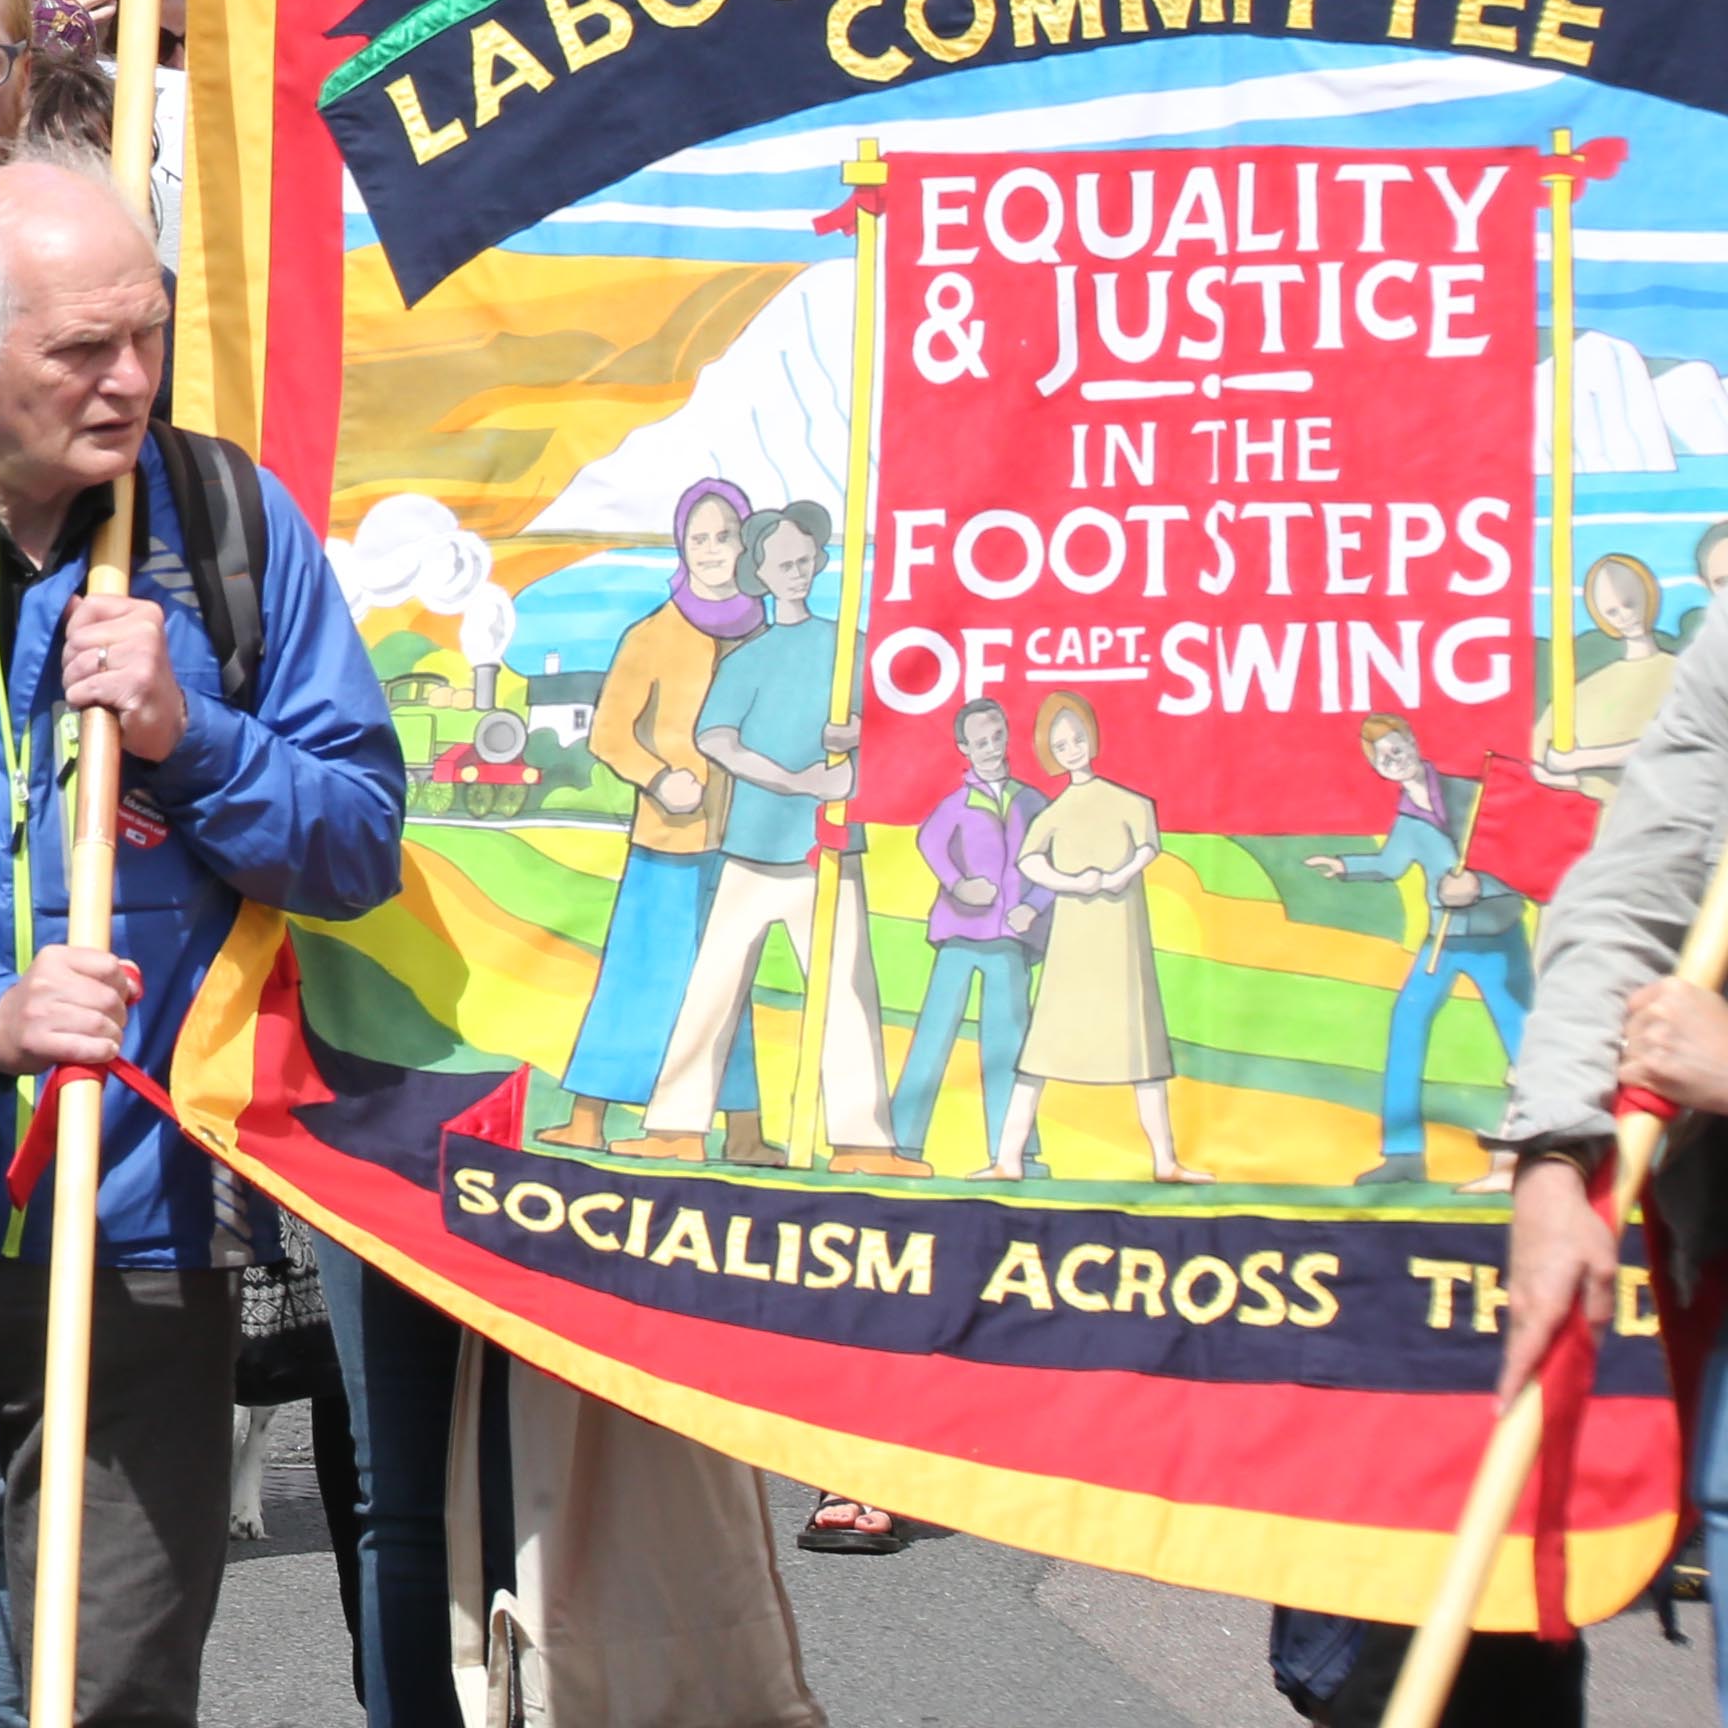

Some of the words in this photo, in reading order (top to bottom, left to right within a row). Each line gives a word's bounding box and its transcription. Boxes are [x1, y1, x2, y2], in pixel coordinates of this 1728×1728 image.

[917, 162, 1510, 266] EQUALITY
[912, 272, 990, 384] &
[1036, 260, 1492, 398] JUSTICE
[1070, 421, 1157, 489] IN
[1192, 417, 1340, 485] THE
[884, 497, 1512, 602] FOOTSTEPS
[871, 626, 1013, 715] OF
[1025, 626, 1150, 666] CAPT.
[1158, 617, 1512, 716] SWING
[455, 1169, 934, 1294] SOCIALISM
[981, 1240, 1340, 1327] ACROSS
[1410, 1258, 1510, 1334] TH
